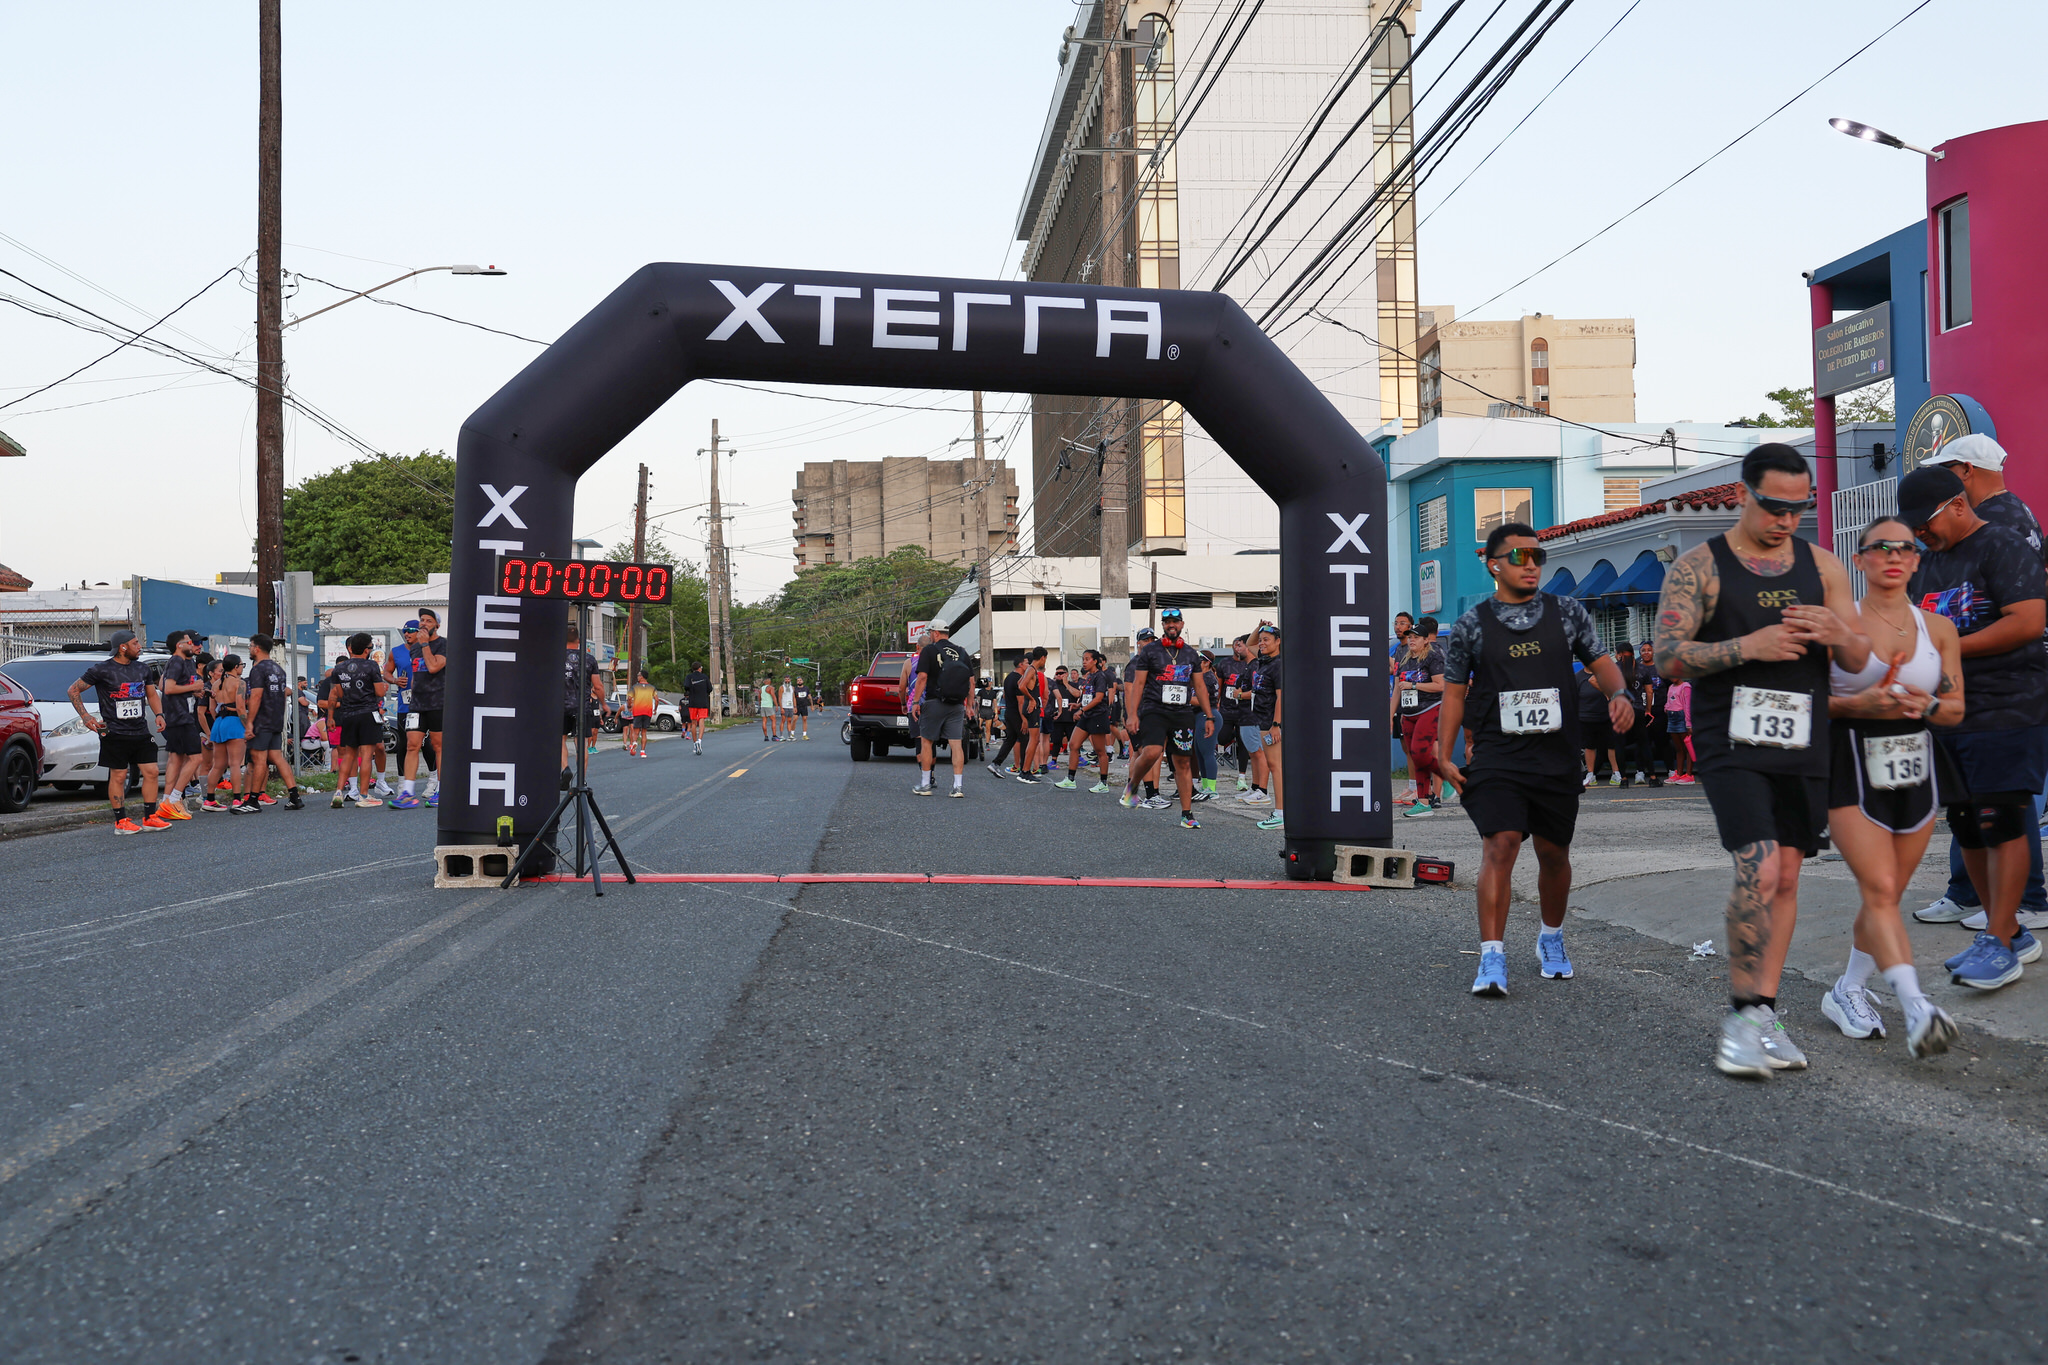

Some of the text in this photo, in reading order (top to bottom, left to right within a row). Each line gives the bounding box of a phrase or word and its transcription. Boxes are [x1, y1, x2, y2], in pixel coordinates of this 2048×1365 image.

[1827, 318, 1874, 342] Salón Educativo
[1818, 329, 1885, 360] COLEGIO DE BARBEROS
[1827, 347, 1876, 372] DE PUERTO RICO
[1905, 436, 1913, 464] COLEGIO
[1910, 427, 1916, 435] DE
[1914, 403, 1934, 426] BARBEROS
[1936, 400, 1956, 413] ESTILISTAS
[1171, 693, 1181, 702] 28
[1521, 691, 1542, 699] FADE
[1532, 697, 1549, 705] RUN
[1765, 692, 1792, 703] FADE
[122, 708, 138, 717] 213
[1778, 702, 1799, 712] RUN
[1514, 708, 1550, 727] 142
[1750, 714, 1795, 739] 133
[1884, 757, 1922, 781] 136
